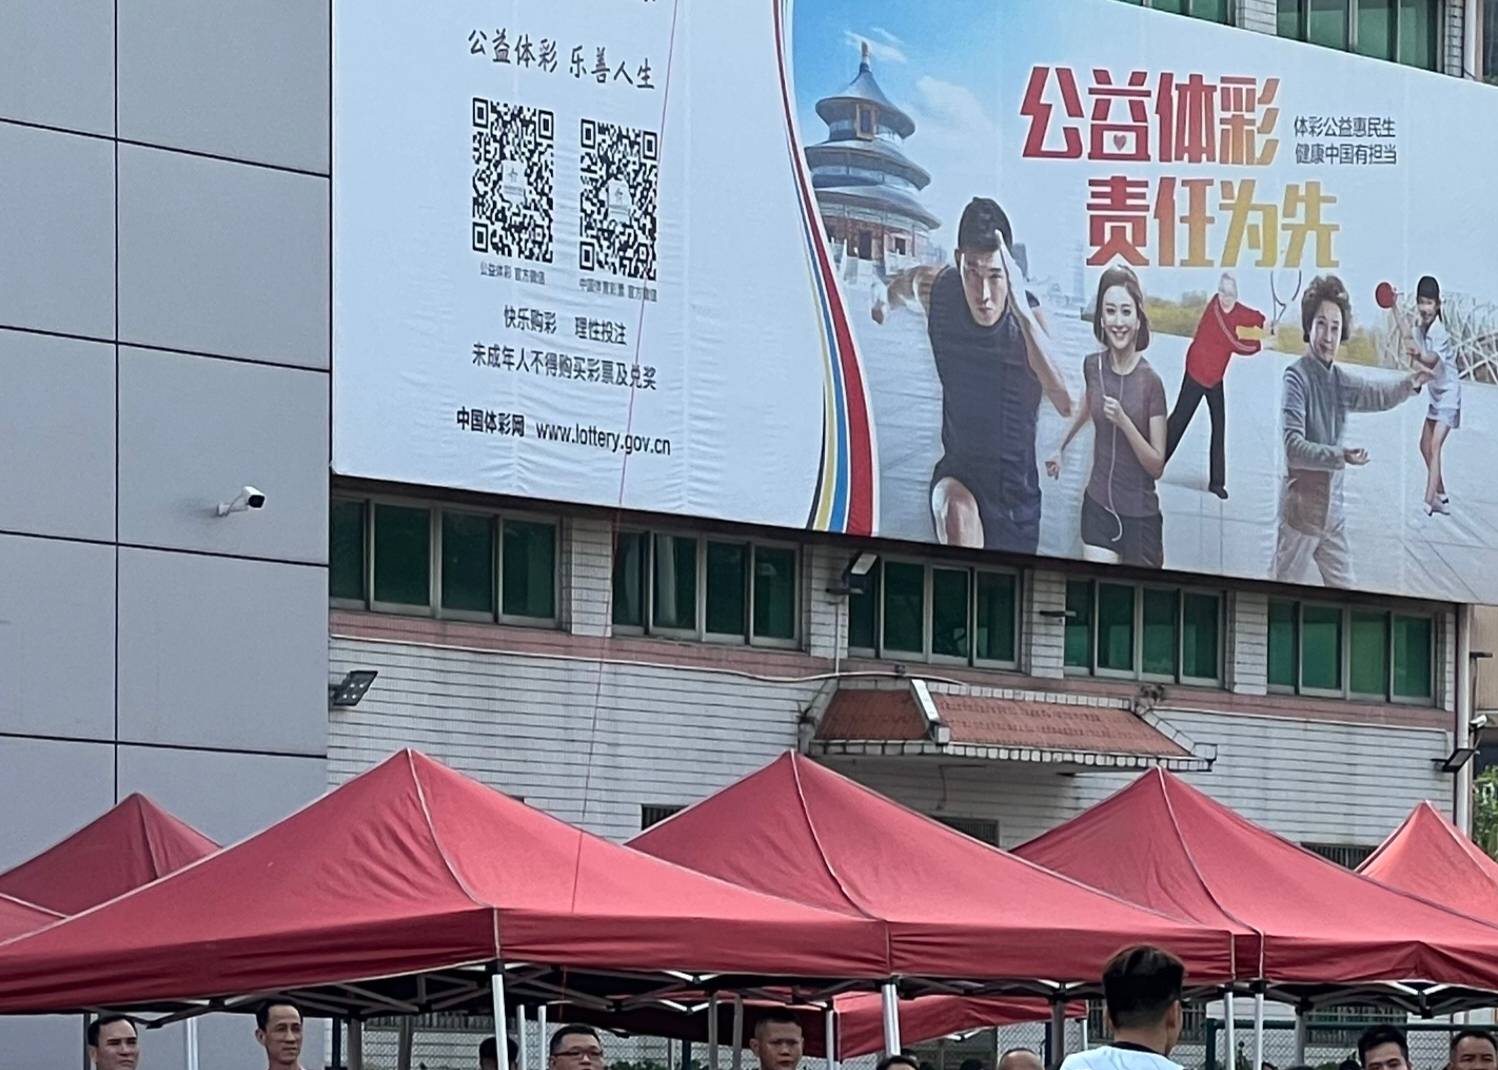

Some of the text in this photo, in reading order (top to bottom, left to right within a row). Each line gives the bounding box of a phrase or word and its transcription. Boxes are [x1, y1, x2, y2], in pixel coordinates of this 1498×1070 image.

[468, 28, 655, 89] 公益体彩 乐善人生
[1020, 65, 1281, 167] 公益体彩
[1294, 116, 1396, 137] 体彩公益惠民生
[1296, 143, 1397, 164] 健康中国有担当
[1086, 175, 1341, 269] 责任为先
[504, 305, 627, 345] 快乐购彩 理性投注
[472, 342, 657, 390] 未成年人不得购买彩票及兑奖
[457, 406, 671, 455] 中国体彩网 www.lottery.gov.cn
